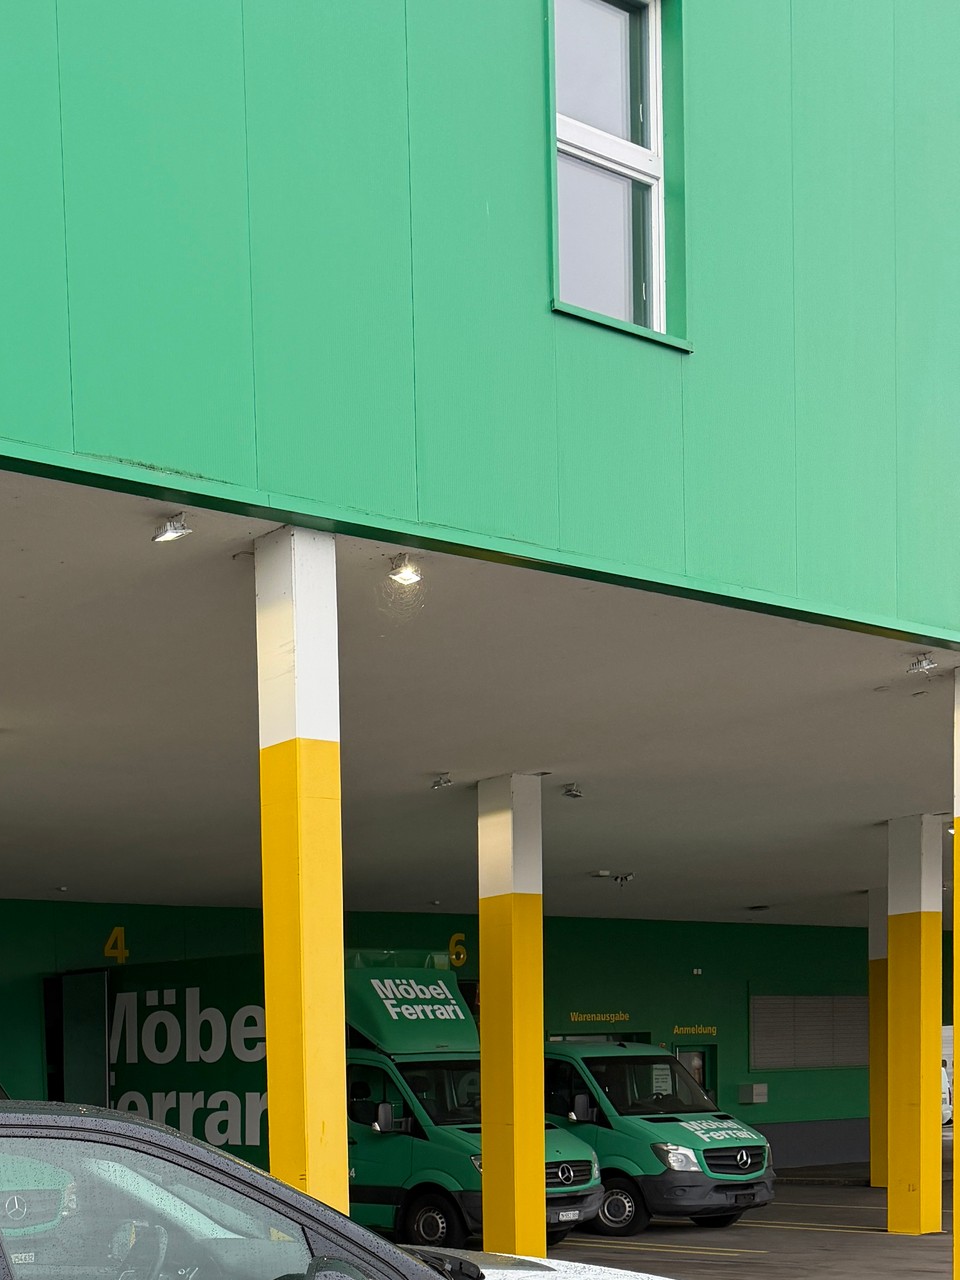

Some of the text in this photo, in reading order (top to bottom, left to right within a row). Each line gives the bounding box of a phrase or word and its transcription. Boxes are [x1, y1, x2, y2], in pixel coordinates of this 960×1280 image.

[104, 927, 129, 964] 4
[449, 933, 467, 967] 6
[370, 979, 453, 999] Möbel
[382, 999, 465, 1020] Ferrari
[570, 1011, 630, 1023] Warenausgabe
[110, 987, 266, 1065] Möbe
[673, 1025, 717, 1036] Anmeldung
[679, 1119, 742, 1132] Möbel
[694, 1128, 759, 1142] Ferrari
